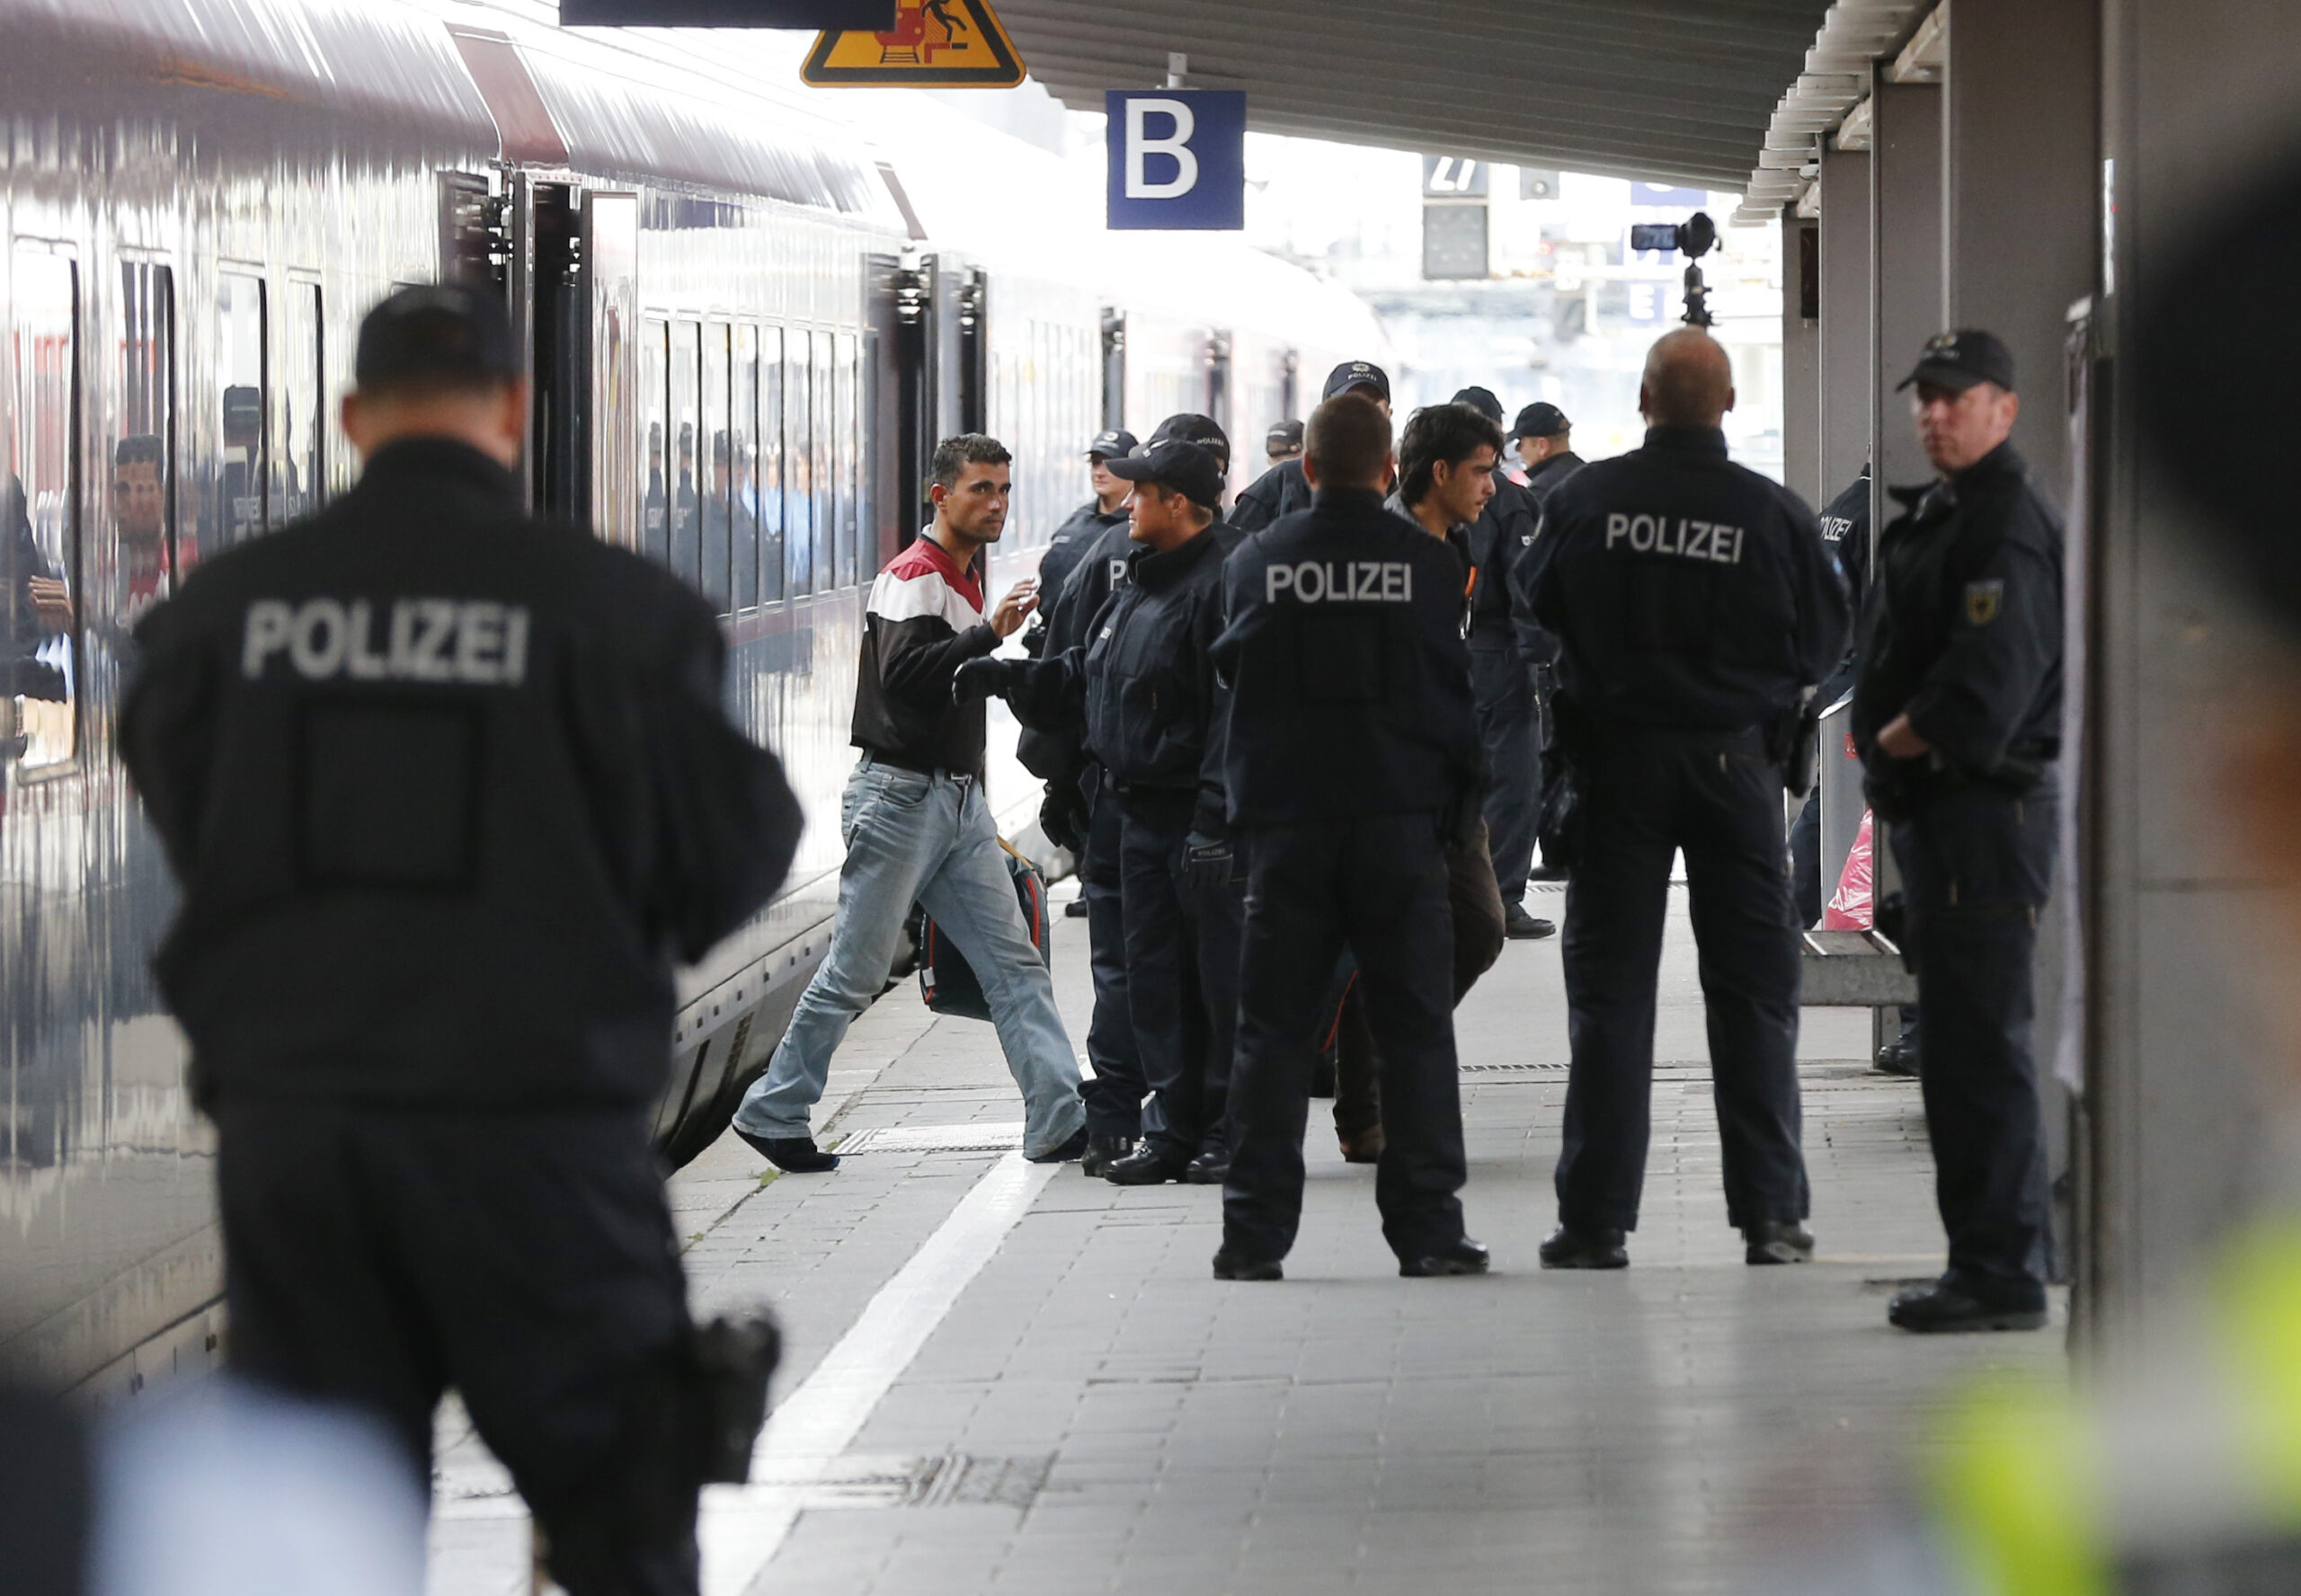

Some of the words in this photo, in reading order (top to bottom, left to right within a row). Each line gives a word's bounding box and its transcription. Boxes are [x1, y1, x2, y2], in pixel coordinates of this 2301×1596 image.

[1124, 98, 1198, 200] B
[1347, 372, 1377, 382] POLIZEI
[1606, 513, 1744, 563] POLIZEI
[1820, 516, 1853, 542] OLIZEI
[1266, 562, 1412, 604] POLIZEI
[242, 599, 529, 683] POLIZEI
